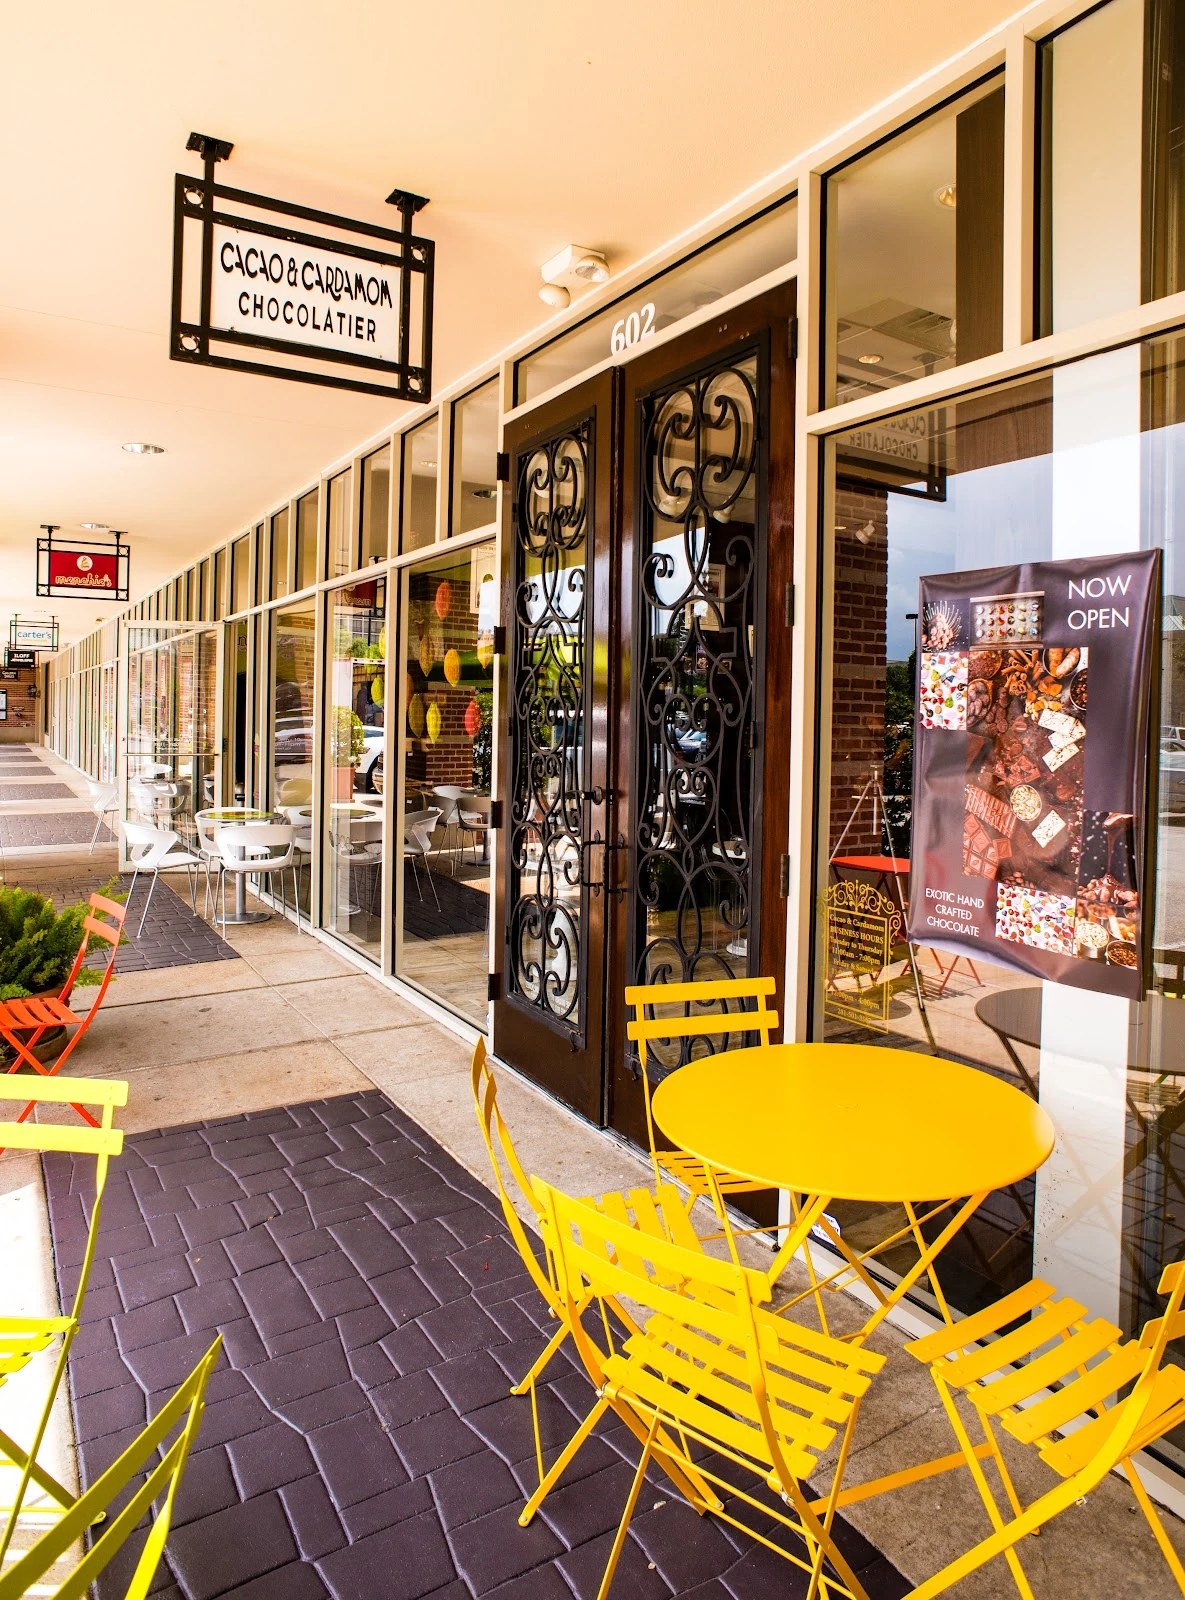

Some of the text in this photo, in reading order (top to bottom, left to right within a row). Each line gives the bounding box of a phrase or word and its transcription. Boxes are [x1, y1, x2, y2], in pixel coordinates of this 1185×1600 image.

[220, 241, 393, 309] CACAO & CARDAMOM
[238, 291, 376, 343] CHOCOLATIER
[610, 302, 656, 357] 602
[1068, 574, 1132, 600] NOW
[1067, 607, 1130, 630] OPEN
[17, 631, 52, 639] carter's
[925, 887, 985, 909] EXOTIC HAND
[829, 913, 847, 924] Cacao
[853, 919, 885, 932] Cardamom
[935, 904, 973, 920] CRAFTED
[829, 925, 884, 944] BUSINESS HOURS
[926, 916, 980, 937] CHOCOLATE
[829, 936, 851, 948] Tuesday
[858, 943, 884, 956] Thursday
